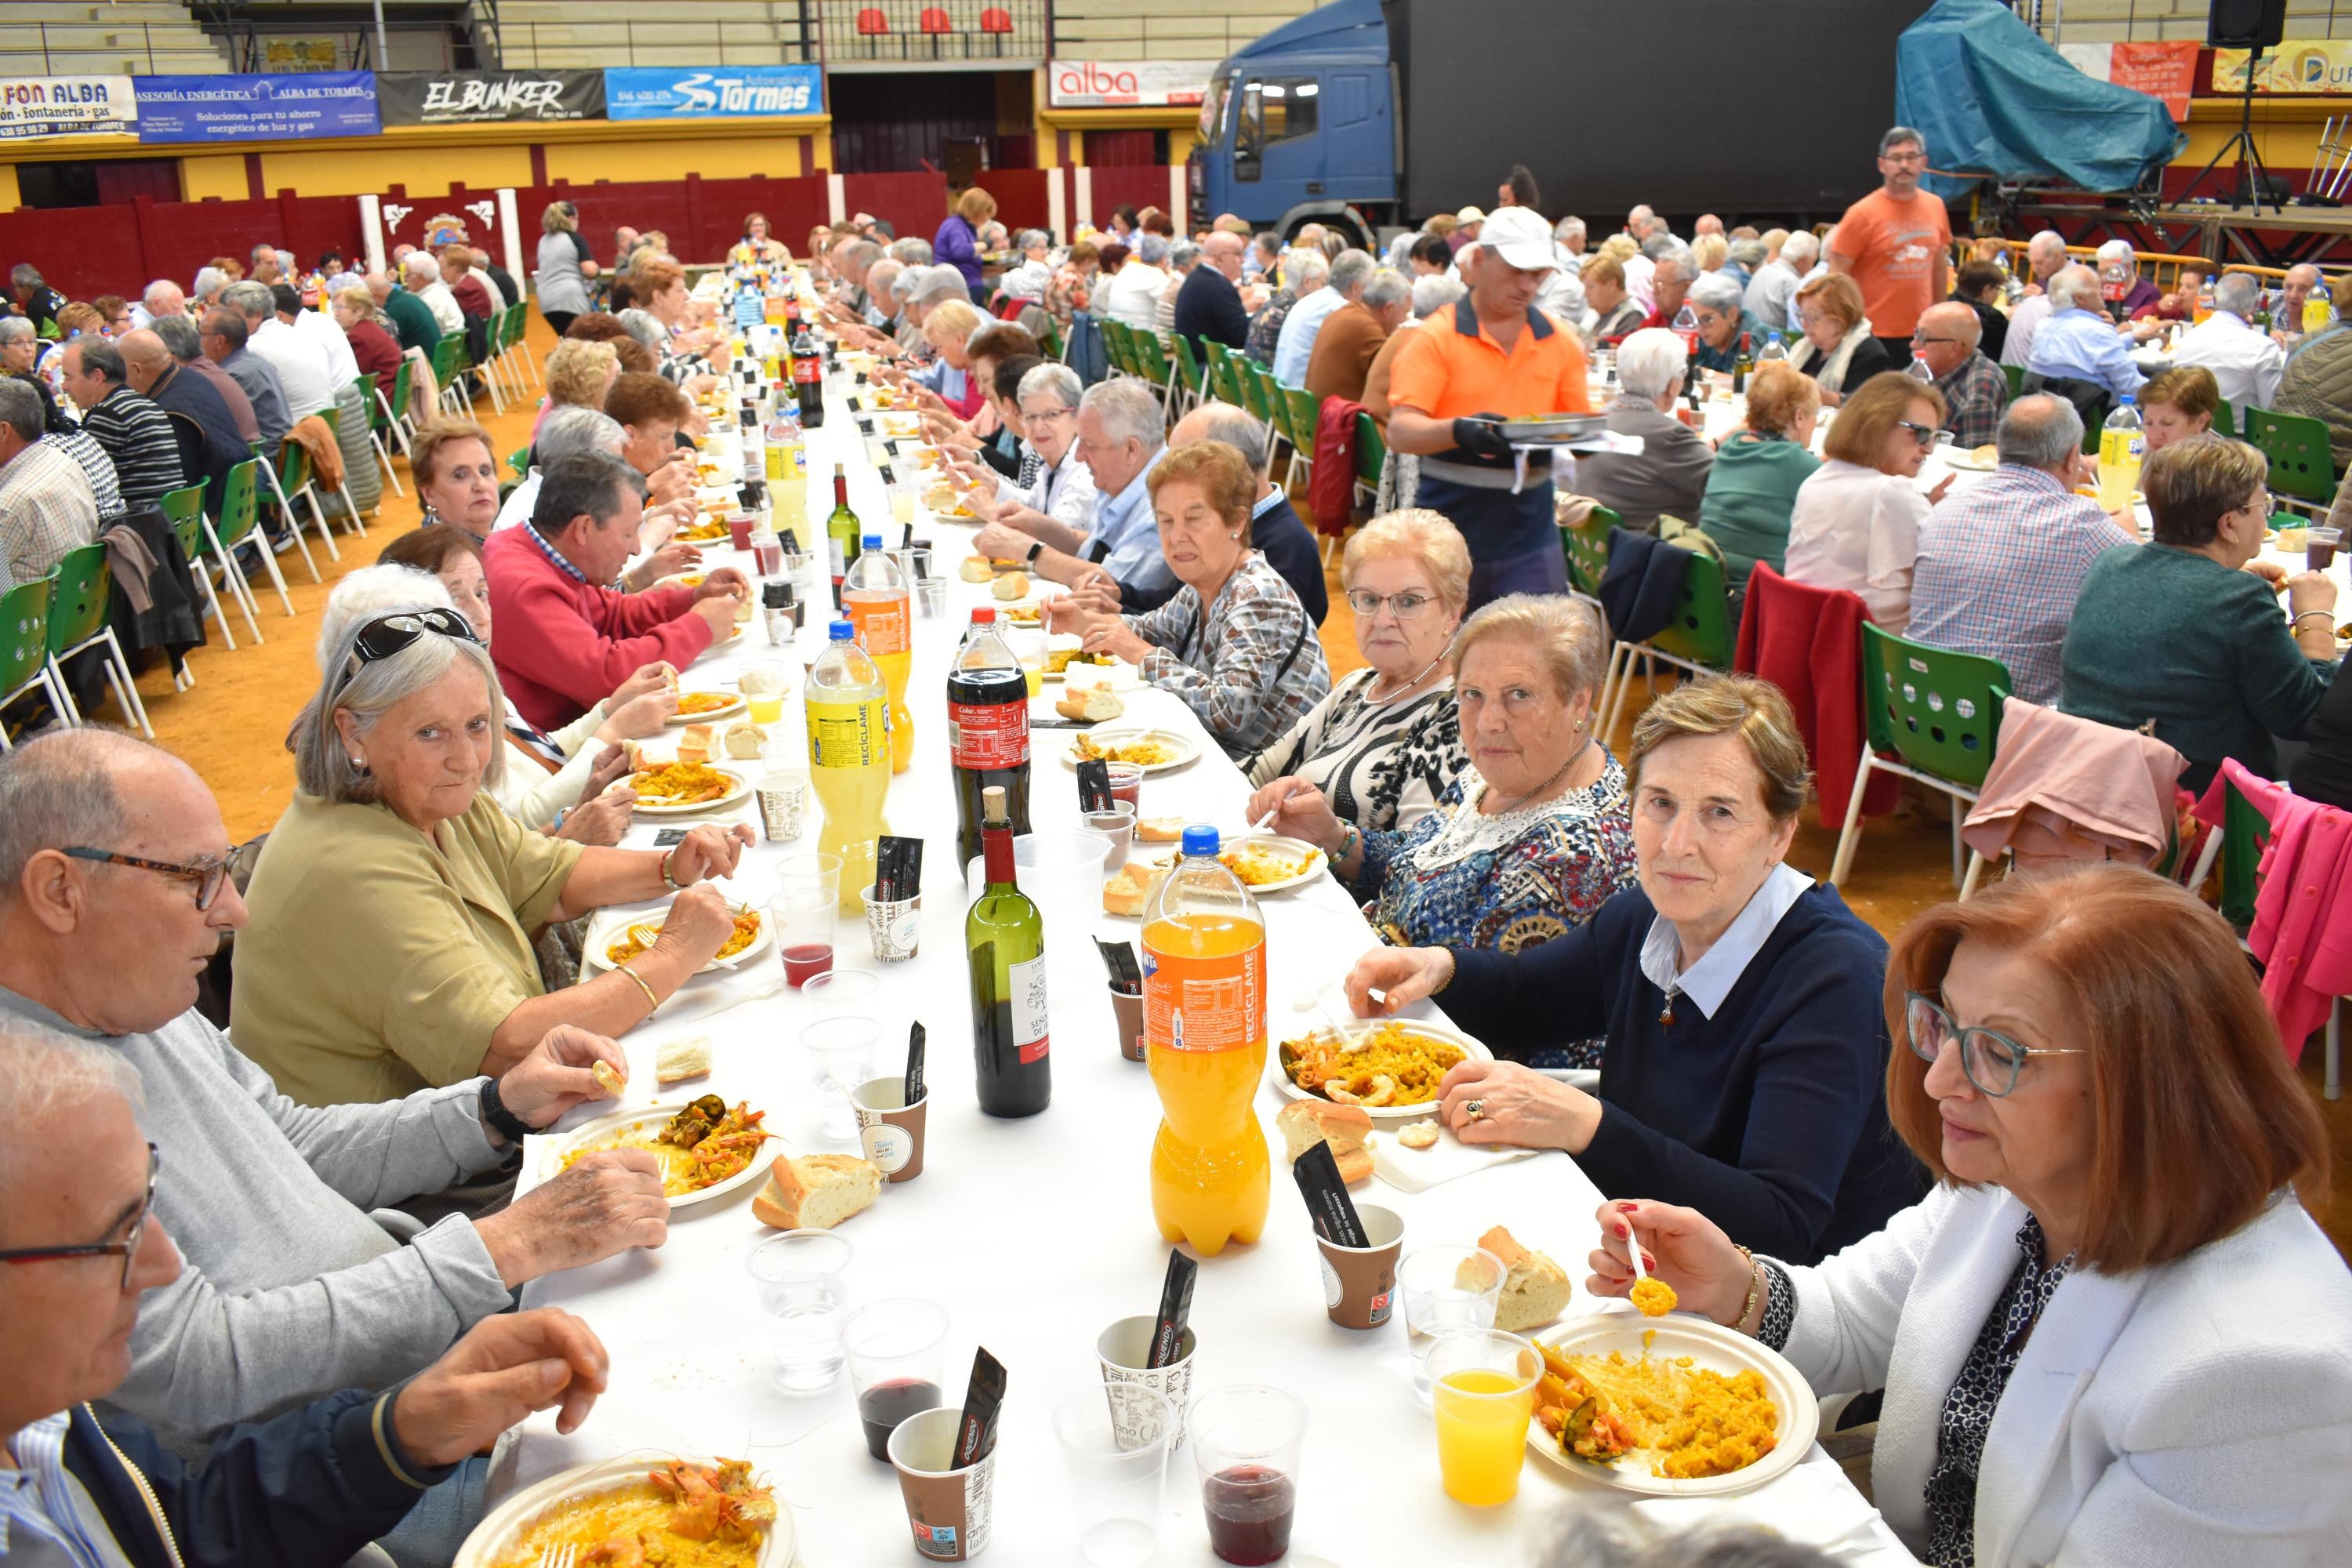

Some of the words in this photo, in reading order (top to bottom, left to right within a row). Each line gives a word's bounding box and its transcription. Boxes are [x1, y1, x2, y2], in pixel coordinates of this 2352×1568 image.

[1059, 62, 1138, 93] alba
[4, 84, 45, 105] FON
[53, 83, 108, 103] ALBA
[136, 89, 185, 100] ASESORÍA
[187, 89, 251, 100] ENERGÉTICA
[278, 88, 306, 98] ALBA
[307, 88, 321, 97] DE
[324, 86, 364, 96] TORMES
[421, 81, 461, 111] EL
[454, 73, 564, 118] BUNKER
[714, 78, 811, 111] Tormes
[93, 107, 111, 119] gas
[196, 112, 249, 122] Soluciones
[252, 112, 273, 122] para
[289, 110, 321, 118] ahorro
[207, 124, 256, 135] energético
[258, 123, 270, 132] de
[272, 122, 288, 131] luz
[298, 122, 315, 132] gas
[859, 705, 869, 766] RECÍCLAME
[1243, 951, 1254, 1043] RECÍCLAME
[1175, 1038, 1182, 1047] 8
[1322, 1189, 1333, 1210] manera
[1332, 1192, 1347, 1221] empezar?
[1330, 1208, 1341, 1230] alguna
[1344, 1219, 1351, 1228] de
[1348, 1228, 1357, 1245] mejor
[1158, 1324, 1171, 1368] OQUENDO
[964, 1420, 976, 1460] OQUENDO
